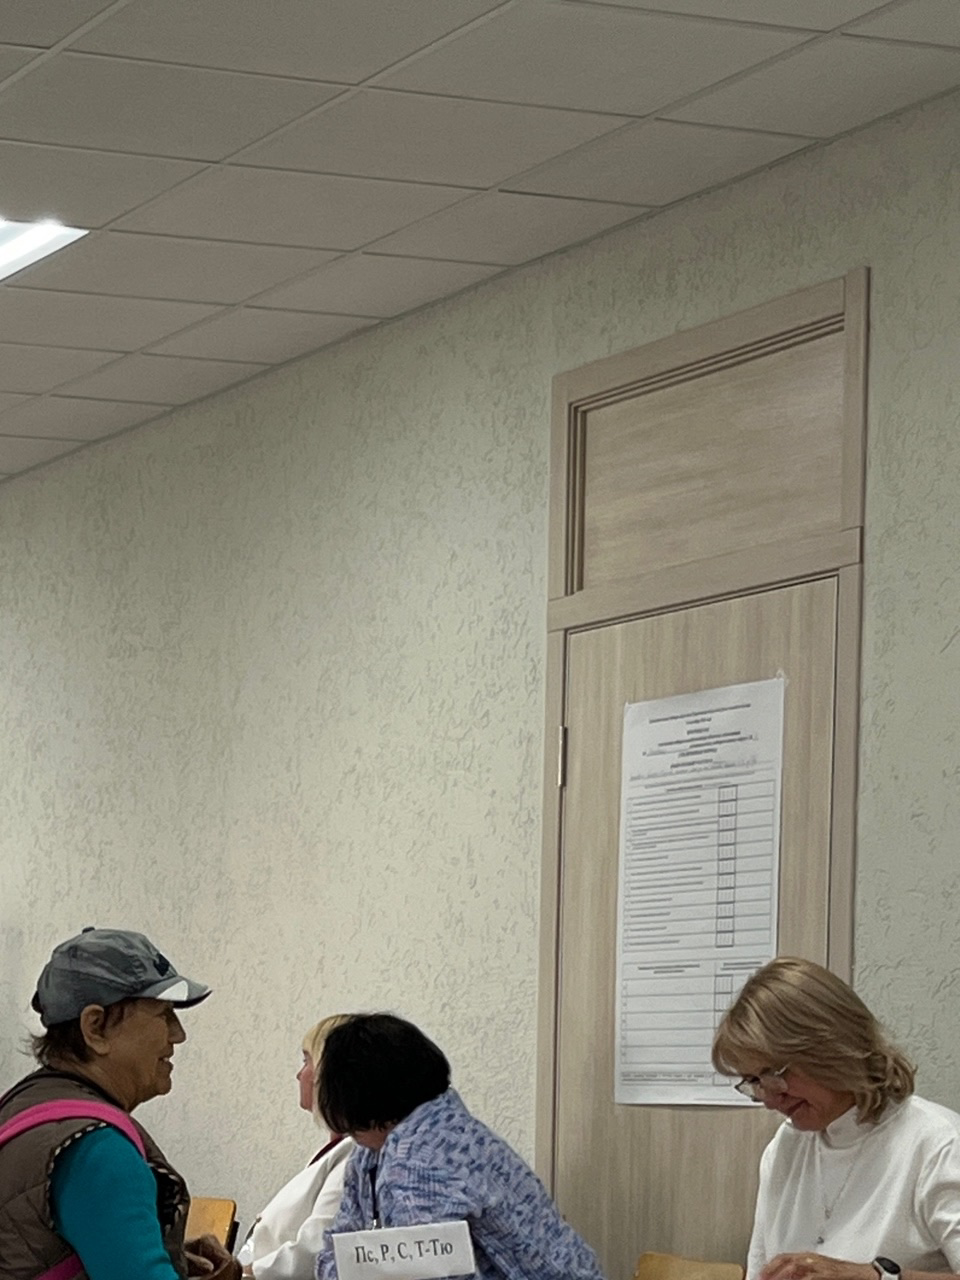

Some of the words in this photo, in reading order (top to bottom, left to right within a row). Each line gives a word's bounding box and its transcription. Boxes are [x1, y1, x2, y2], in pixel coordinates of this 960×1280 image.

[354, 1245, 380, 1265] Пс,
[380, 1243, 396, 1263] Р,
[397, 1241, 414, 1259] С,
[414, 1238, 454, 1258] Т-Тю
